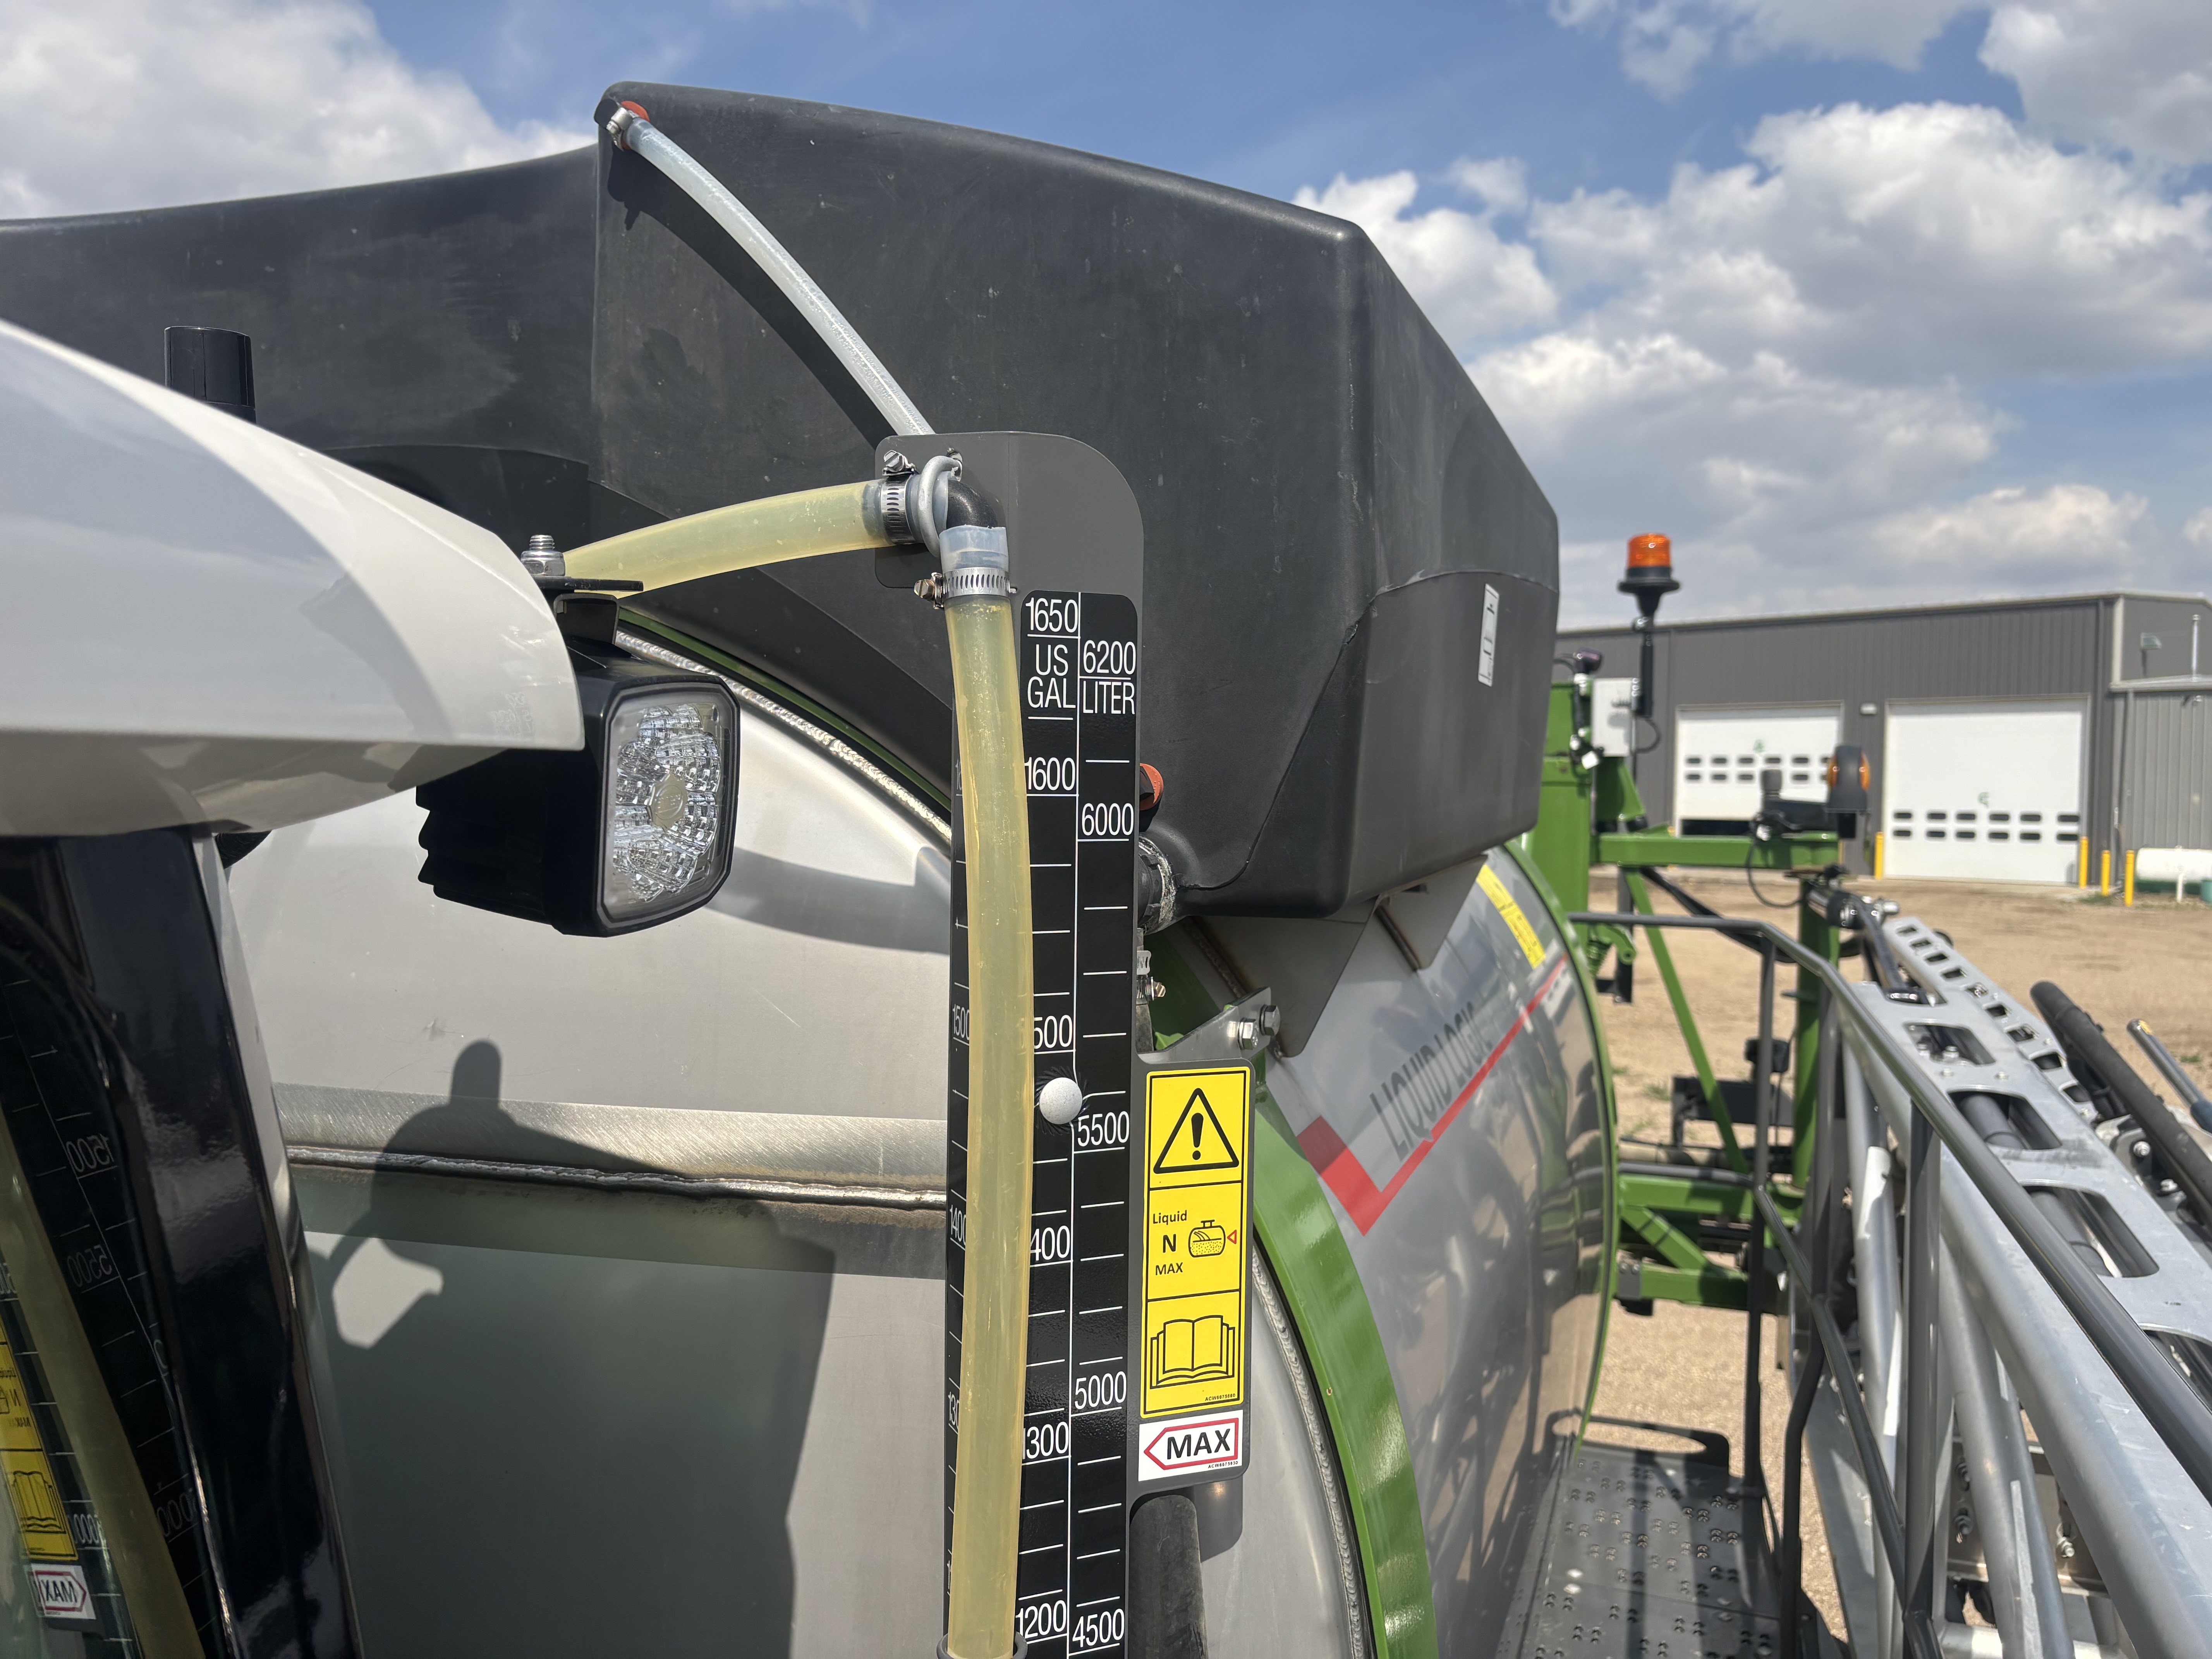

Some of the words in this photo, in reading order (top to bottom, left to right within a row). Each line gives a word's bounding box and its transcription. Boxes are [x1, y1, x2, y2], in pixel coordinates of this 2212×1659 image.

[1025, 597, 1078, 633] 1650
[1036, 644, 1069, 676] US
[1083, 640, 1136, 675] 6200
[1027, 676, 1076, 709] GAL
[1083, 681, 1135, 715] LITER
[1024, 757, 1076, 791] 1600
[1082, 803, 1134, 836] 6000
[1034, 1015, 1072, 1049] 500
[1369, 1045, 1452, 1161] LIQUID
[1077, 1111, 1130, 1147] 5500
[1153, 1210, 1187, 1226] Liquid
[1030, 1225, 1070, 1261] 400
[1163, 1234, 1176, 1253] N
[1155, 1262, 1183, 1276] MAX
[1075, 1371, 1127, 1410] 5000
[1167, 1429, 1230, 1460] MAX
[1015, 1600, 1066, 1637] 1200
[1072, 1608, 1125, 1648] 4500
